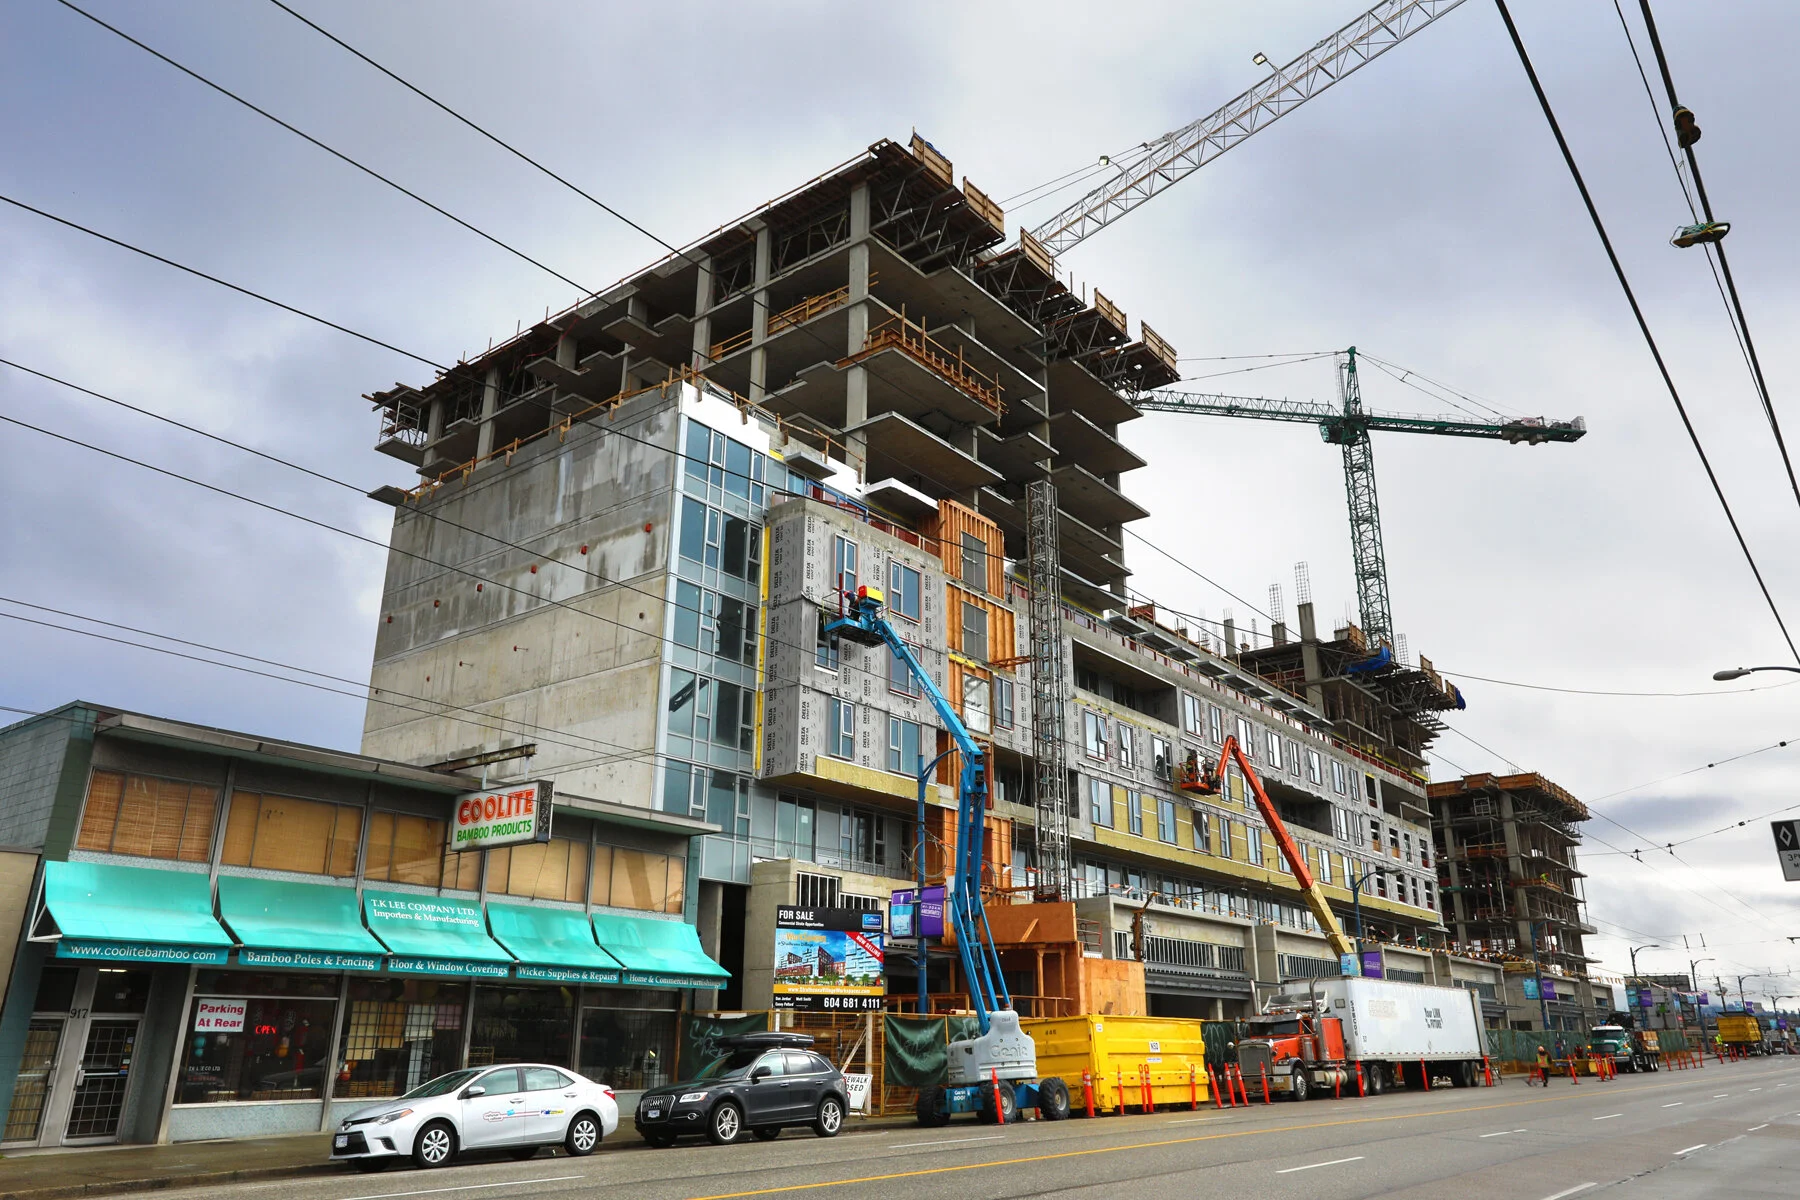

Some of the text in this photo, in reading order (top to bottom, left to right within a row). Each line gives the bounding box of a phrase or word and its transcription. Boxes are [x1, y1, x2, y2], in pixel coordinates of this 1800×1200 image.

[458, 789, 535, 825] COOLITE
[457, 820, 532, 842] BAMBOO PRODUCTS
[371, 899, 477, 916] T.K LEE COMPANY LTD.
[779, 910, 814, 920] FOR SALE
[373, 909, 412, 920] Importers
[424, 914, 479, 927] Manufacturing
[856, 935, 881, 957] NOW SELLING
[247, 952, 374, 969] Bamboo Poles & Fencing
[390, 960, 507, 976] Floor & Window Coverings
[519, 967, 547, 977] Wicker
[548, 969, 580, 980] Supplies
[590, 972, 617, 982] Repairs
[629, 974, 647, 982] Home
[656, 976, 688, 985] Commercial
[690, 978, 721, 988] Furnishings
[200, 1004, 244, 1015] Parking
[824, 998, 880, 1008] 604 681 4111
[70, 1009, 88, 1019] 917
[198, 1018, 242, 1027] At Rear
[991, 1044, 1027, 1057] Genie
